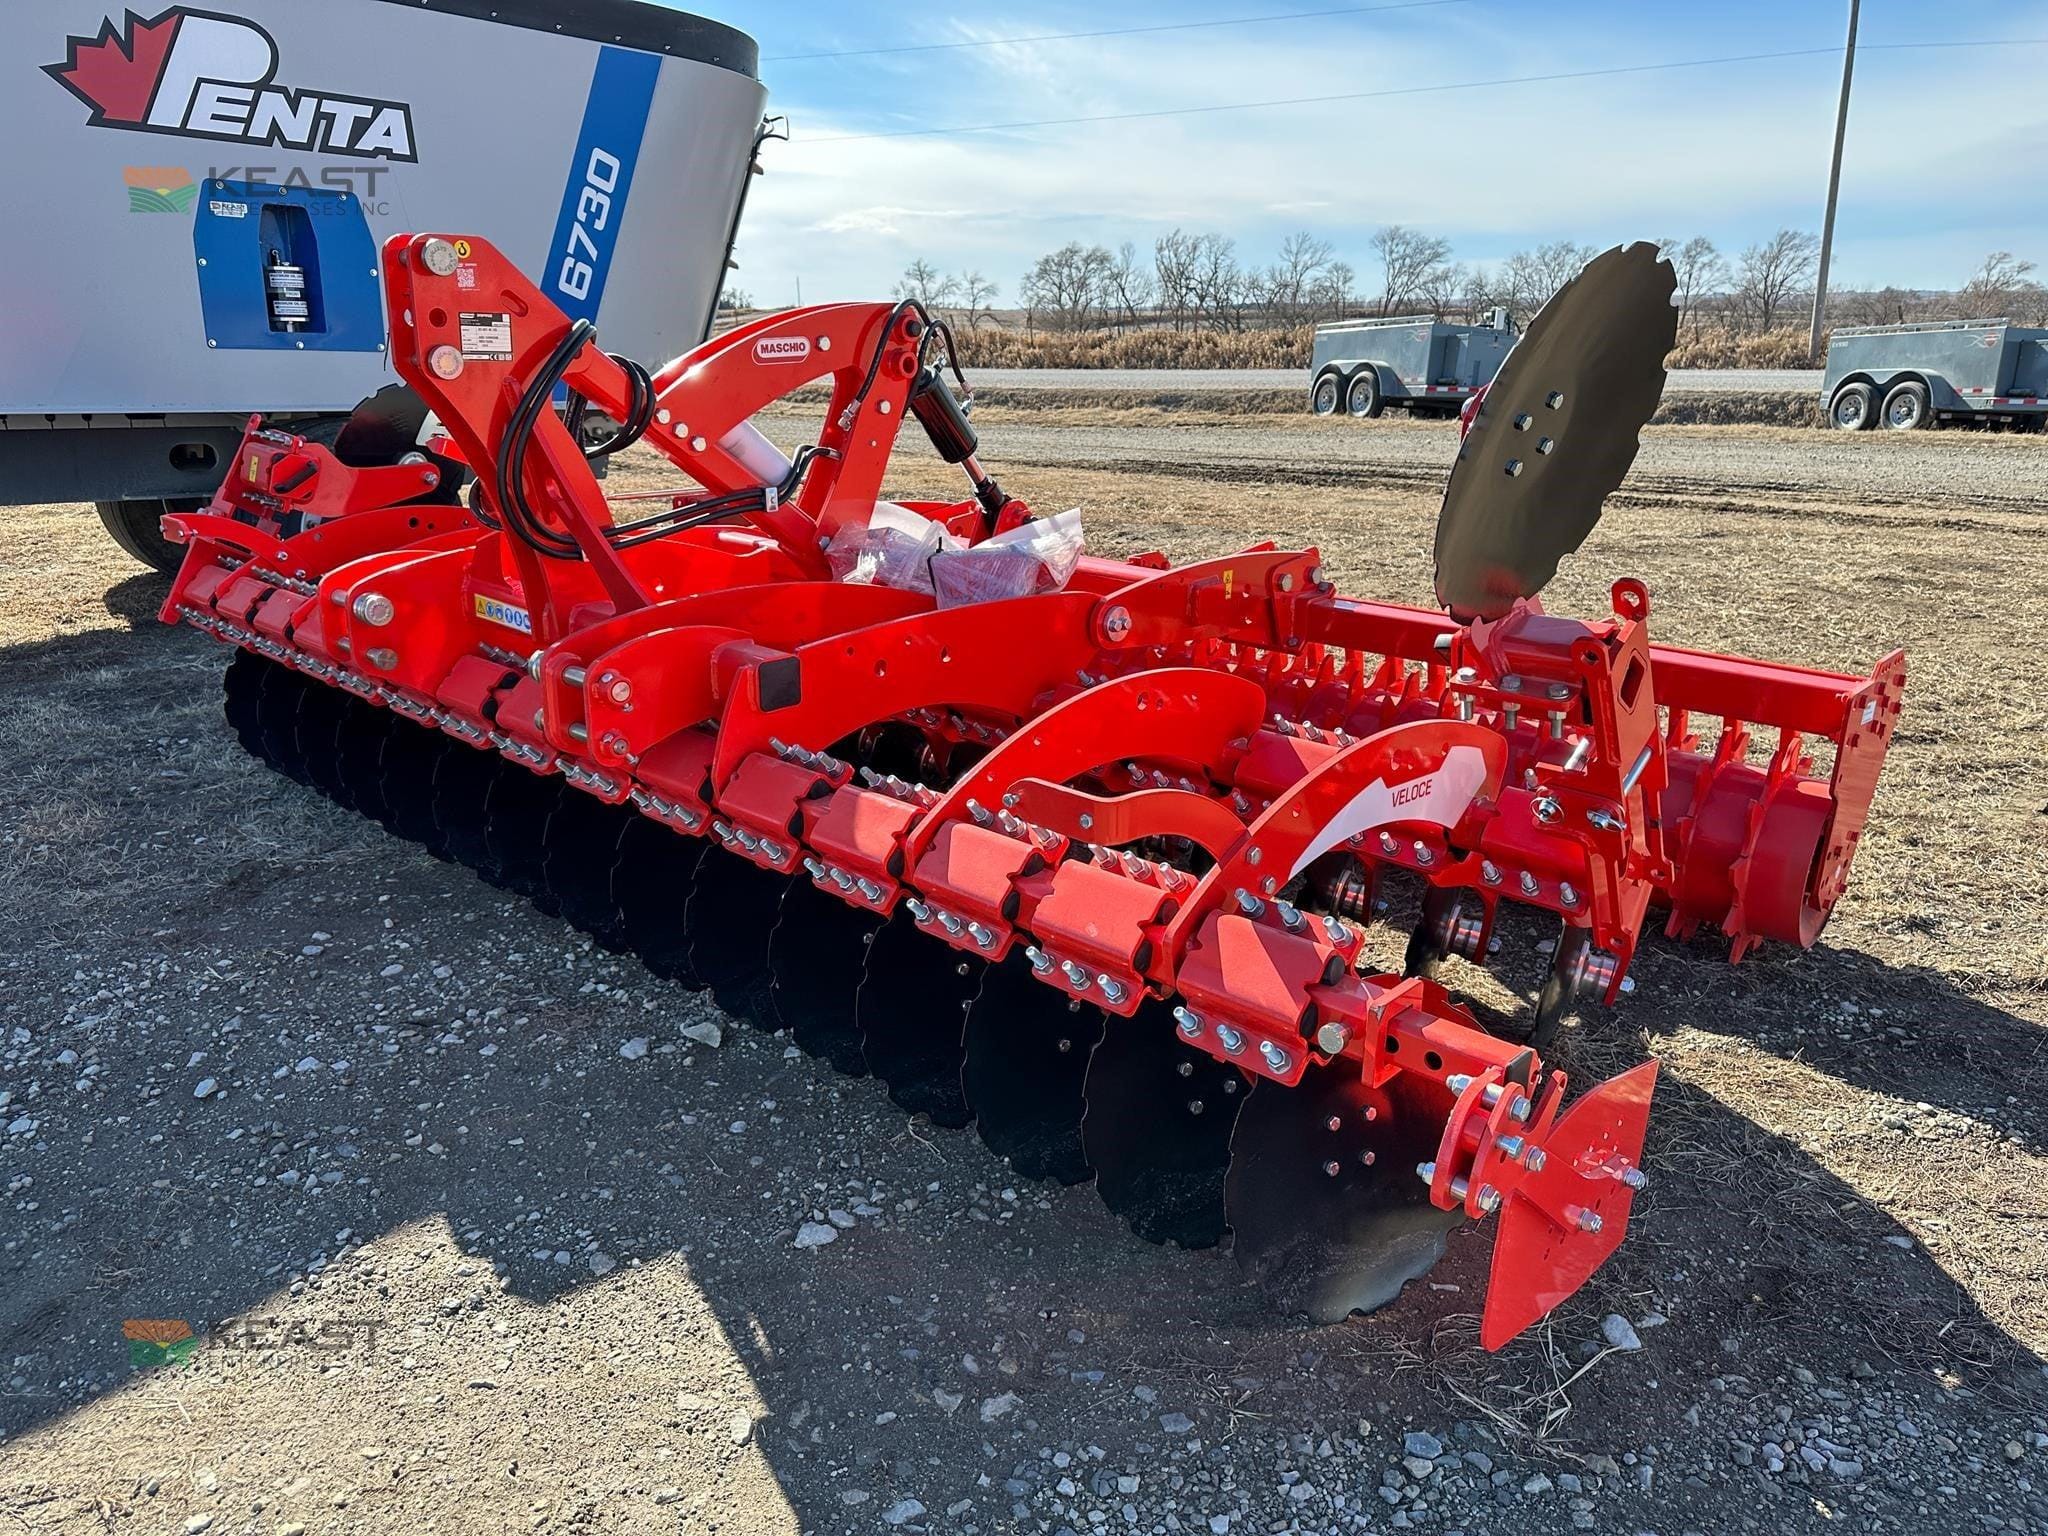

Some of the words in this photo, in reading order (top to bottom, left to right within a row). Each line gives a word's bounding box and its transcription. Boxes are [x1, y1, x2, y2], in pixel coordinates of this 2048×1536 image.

[147, 14, 412, 155] PENTA
[558, 147, 621, 301] 6730
[760, 342, 806, 354] MASCHIO
[1392, 779, 1433, 808] VELOCE
